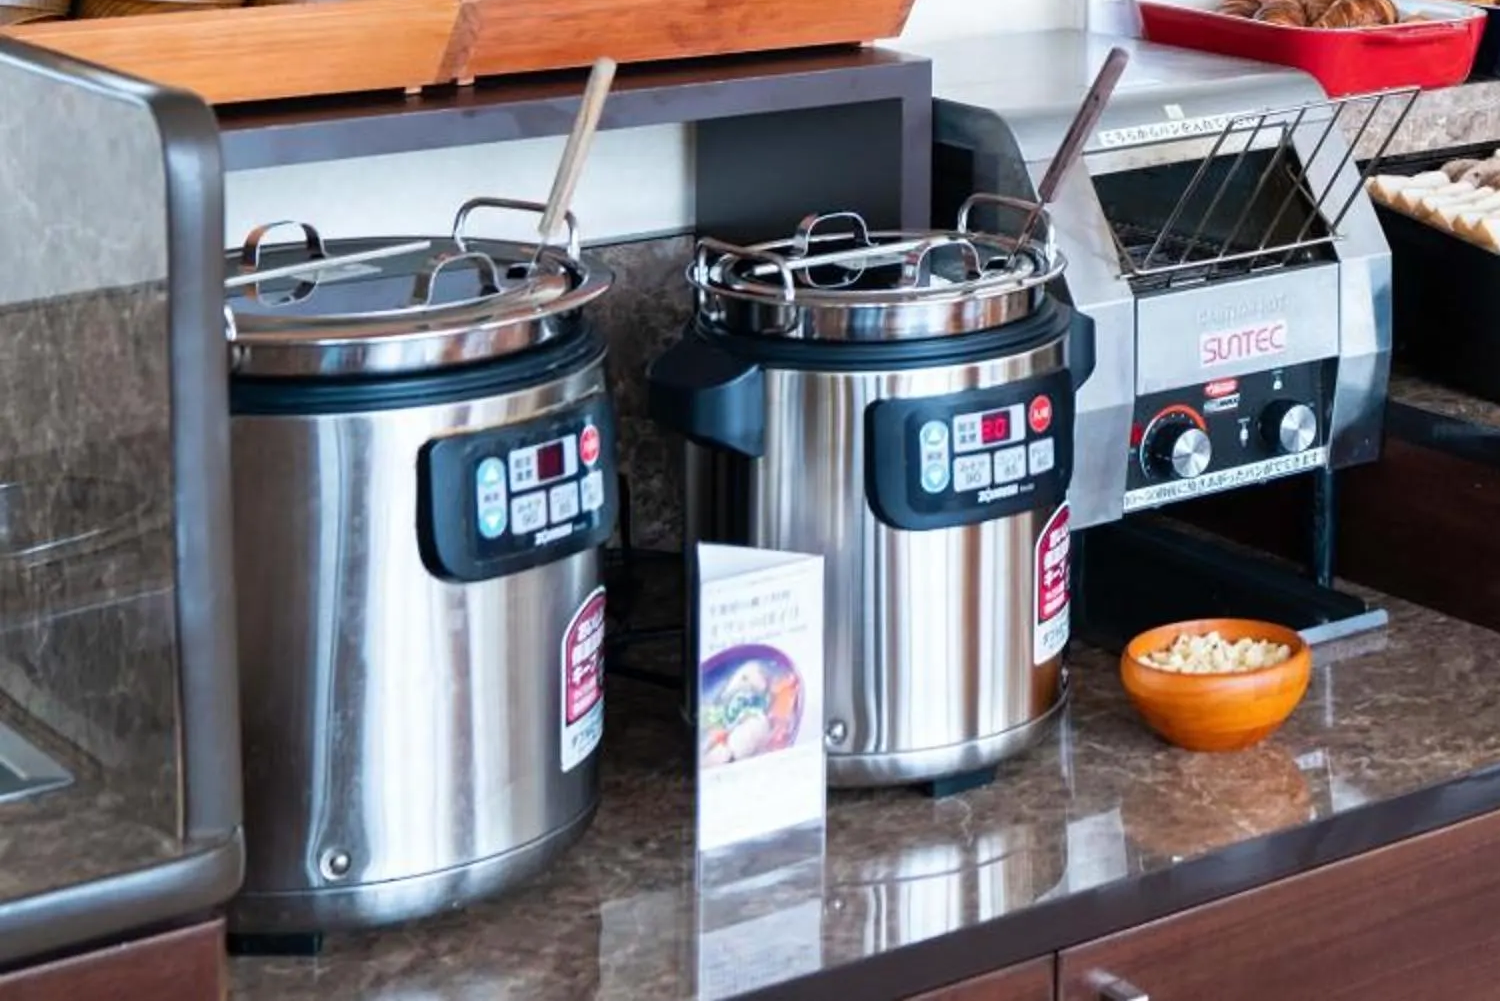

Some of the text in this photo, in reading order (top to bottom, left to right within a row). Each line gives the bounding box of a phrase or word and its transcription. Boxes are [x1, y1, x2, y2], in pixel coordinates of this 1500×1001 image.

[1104, 114, 1256, 144] こちらからパンを入れてだ
[1203, 324, 1284, 364] SUNTEC
